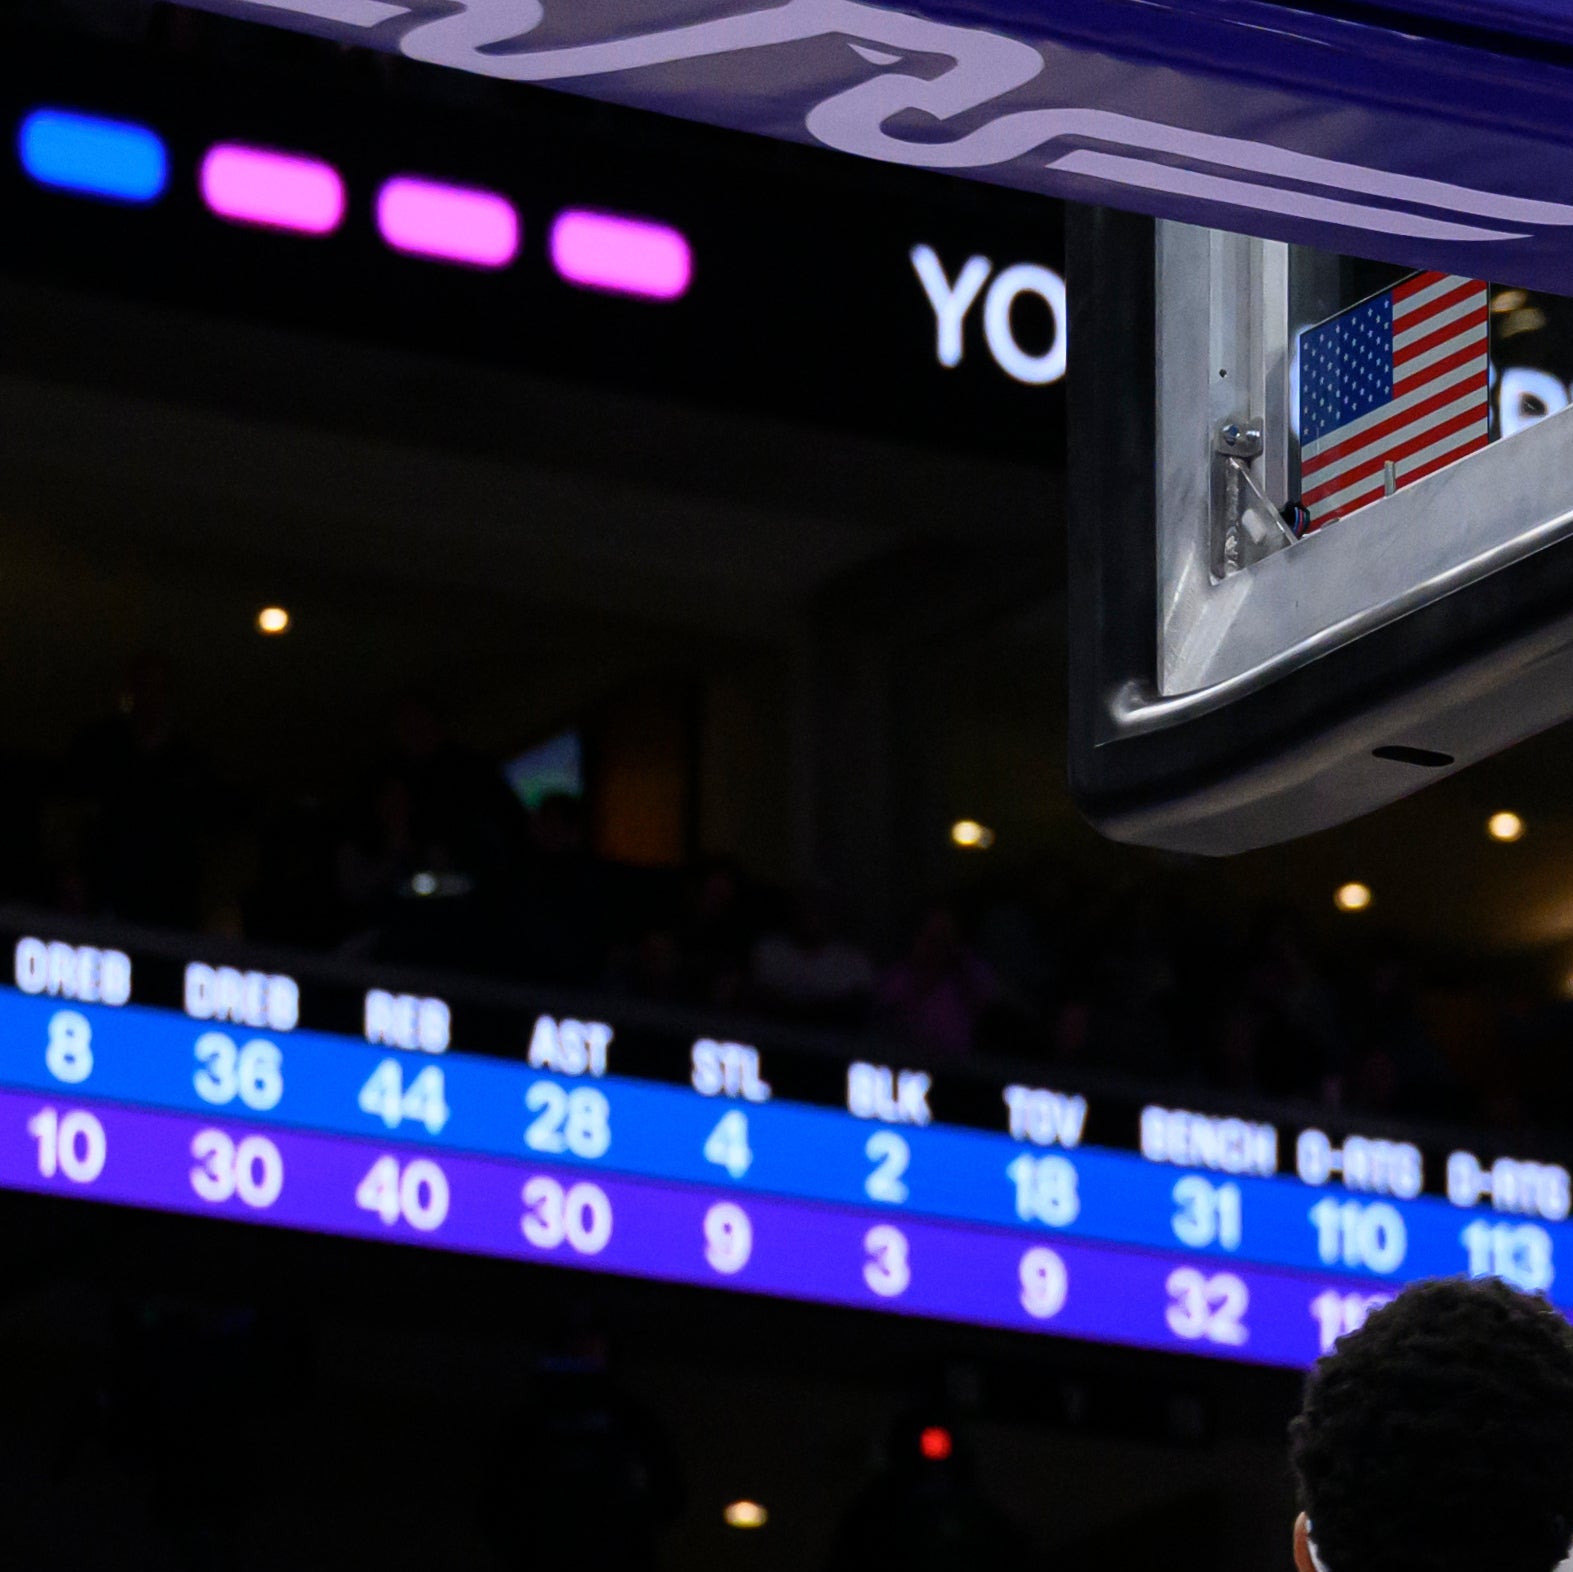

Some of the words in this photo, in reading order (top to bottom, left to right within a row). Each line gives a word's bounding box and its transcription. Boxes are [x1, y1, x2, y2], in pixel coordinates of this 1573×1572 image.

[15, 937, 131, 1006] OREB
[185, 963, 299, 1031] DREB
[365, 990, 450, 1053] REB
[529, 1016, 611, 1074] AST
[692, 1040, 767, 1101] STL
[848, 1063, 930, 1123] BLK
[1004, 1086, 1085, 1147] TOV
[1140, 1106, 1277, 1173] BENCH
[46, 1011, 92, 1083] 8
[193, 1031, 284, 1110] 36
[359, 1060, 448, 1134] 44
[526, 1082, 610, 1158] 28
[704, 1110, 752, 1178] 4
[867, 1133, 908, 1202] 2
[1012, 1156, 1078, 1225] 18
[1172, 1177, 1241, 1250] 31
[1314, 1200, 1404, 1271] 110
[29, 1109, 107, 1183] 10
[191, 1129, 283, 1208] 30
[356, 1156, 450, 1231] 40
[521, 1177, 613, 1254] 30
[704, 1202, 752, 1274] 9
[864, 1225, 910, 1297] 3
[1019, 1247, 1067, 1318] 9
[1166, 1268, 1248, 1345] 32
[1313, 1291, 1391, 1353] 11
